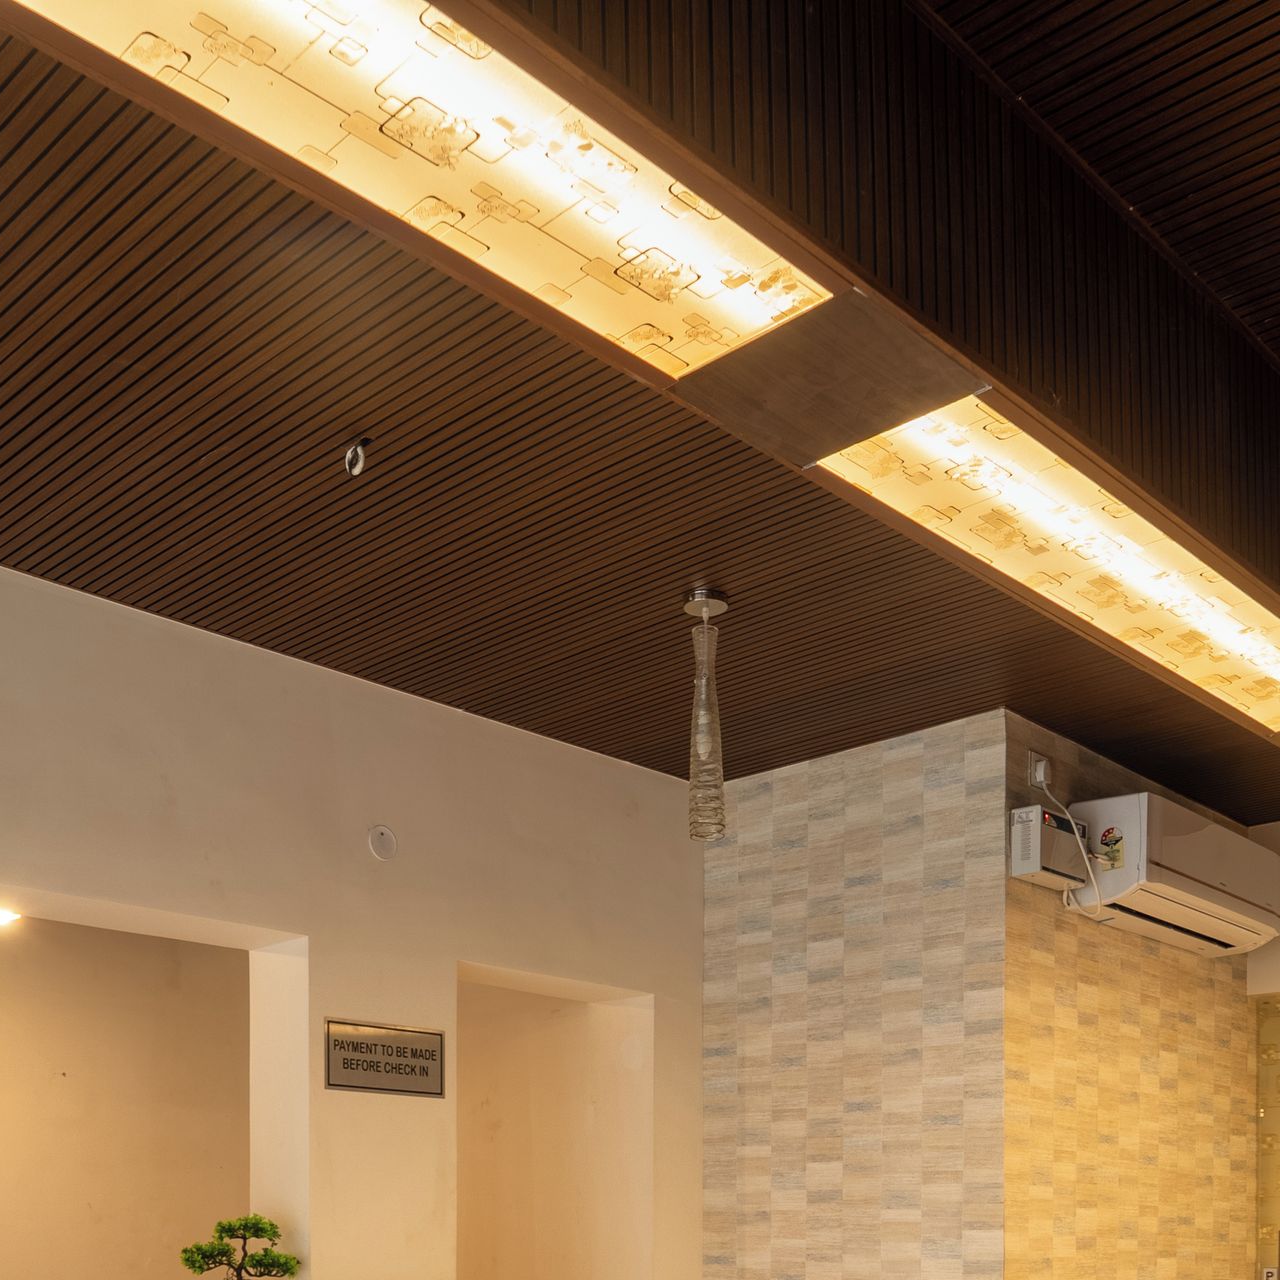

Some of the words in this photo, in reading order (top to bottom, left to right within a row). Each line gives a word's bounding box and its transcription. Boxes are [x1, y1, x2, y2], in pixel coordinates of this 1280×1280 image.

[334, 1039, 378, 1055] PAYMENT
[381, 1045, 393, 1056] TO
[396, 1047, 408, 1058] BE
[411, 1048, 437, 1061] MADE
[343, 1058, 381, 1072] BEFORE
[384, 1062, 417, 1075] CHECK
[419, 1066, 428, 1077] IN
